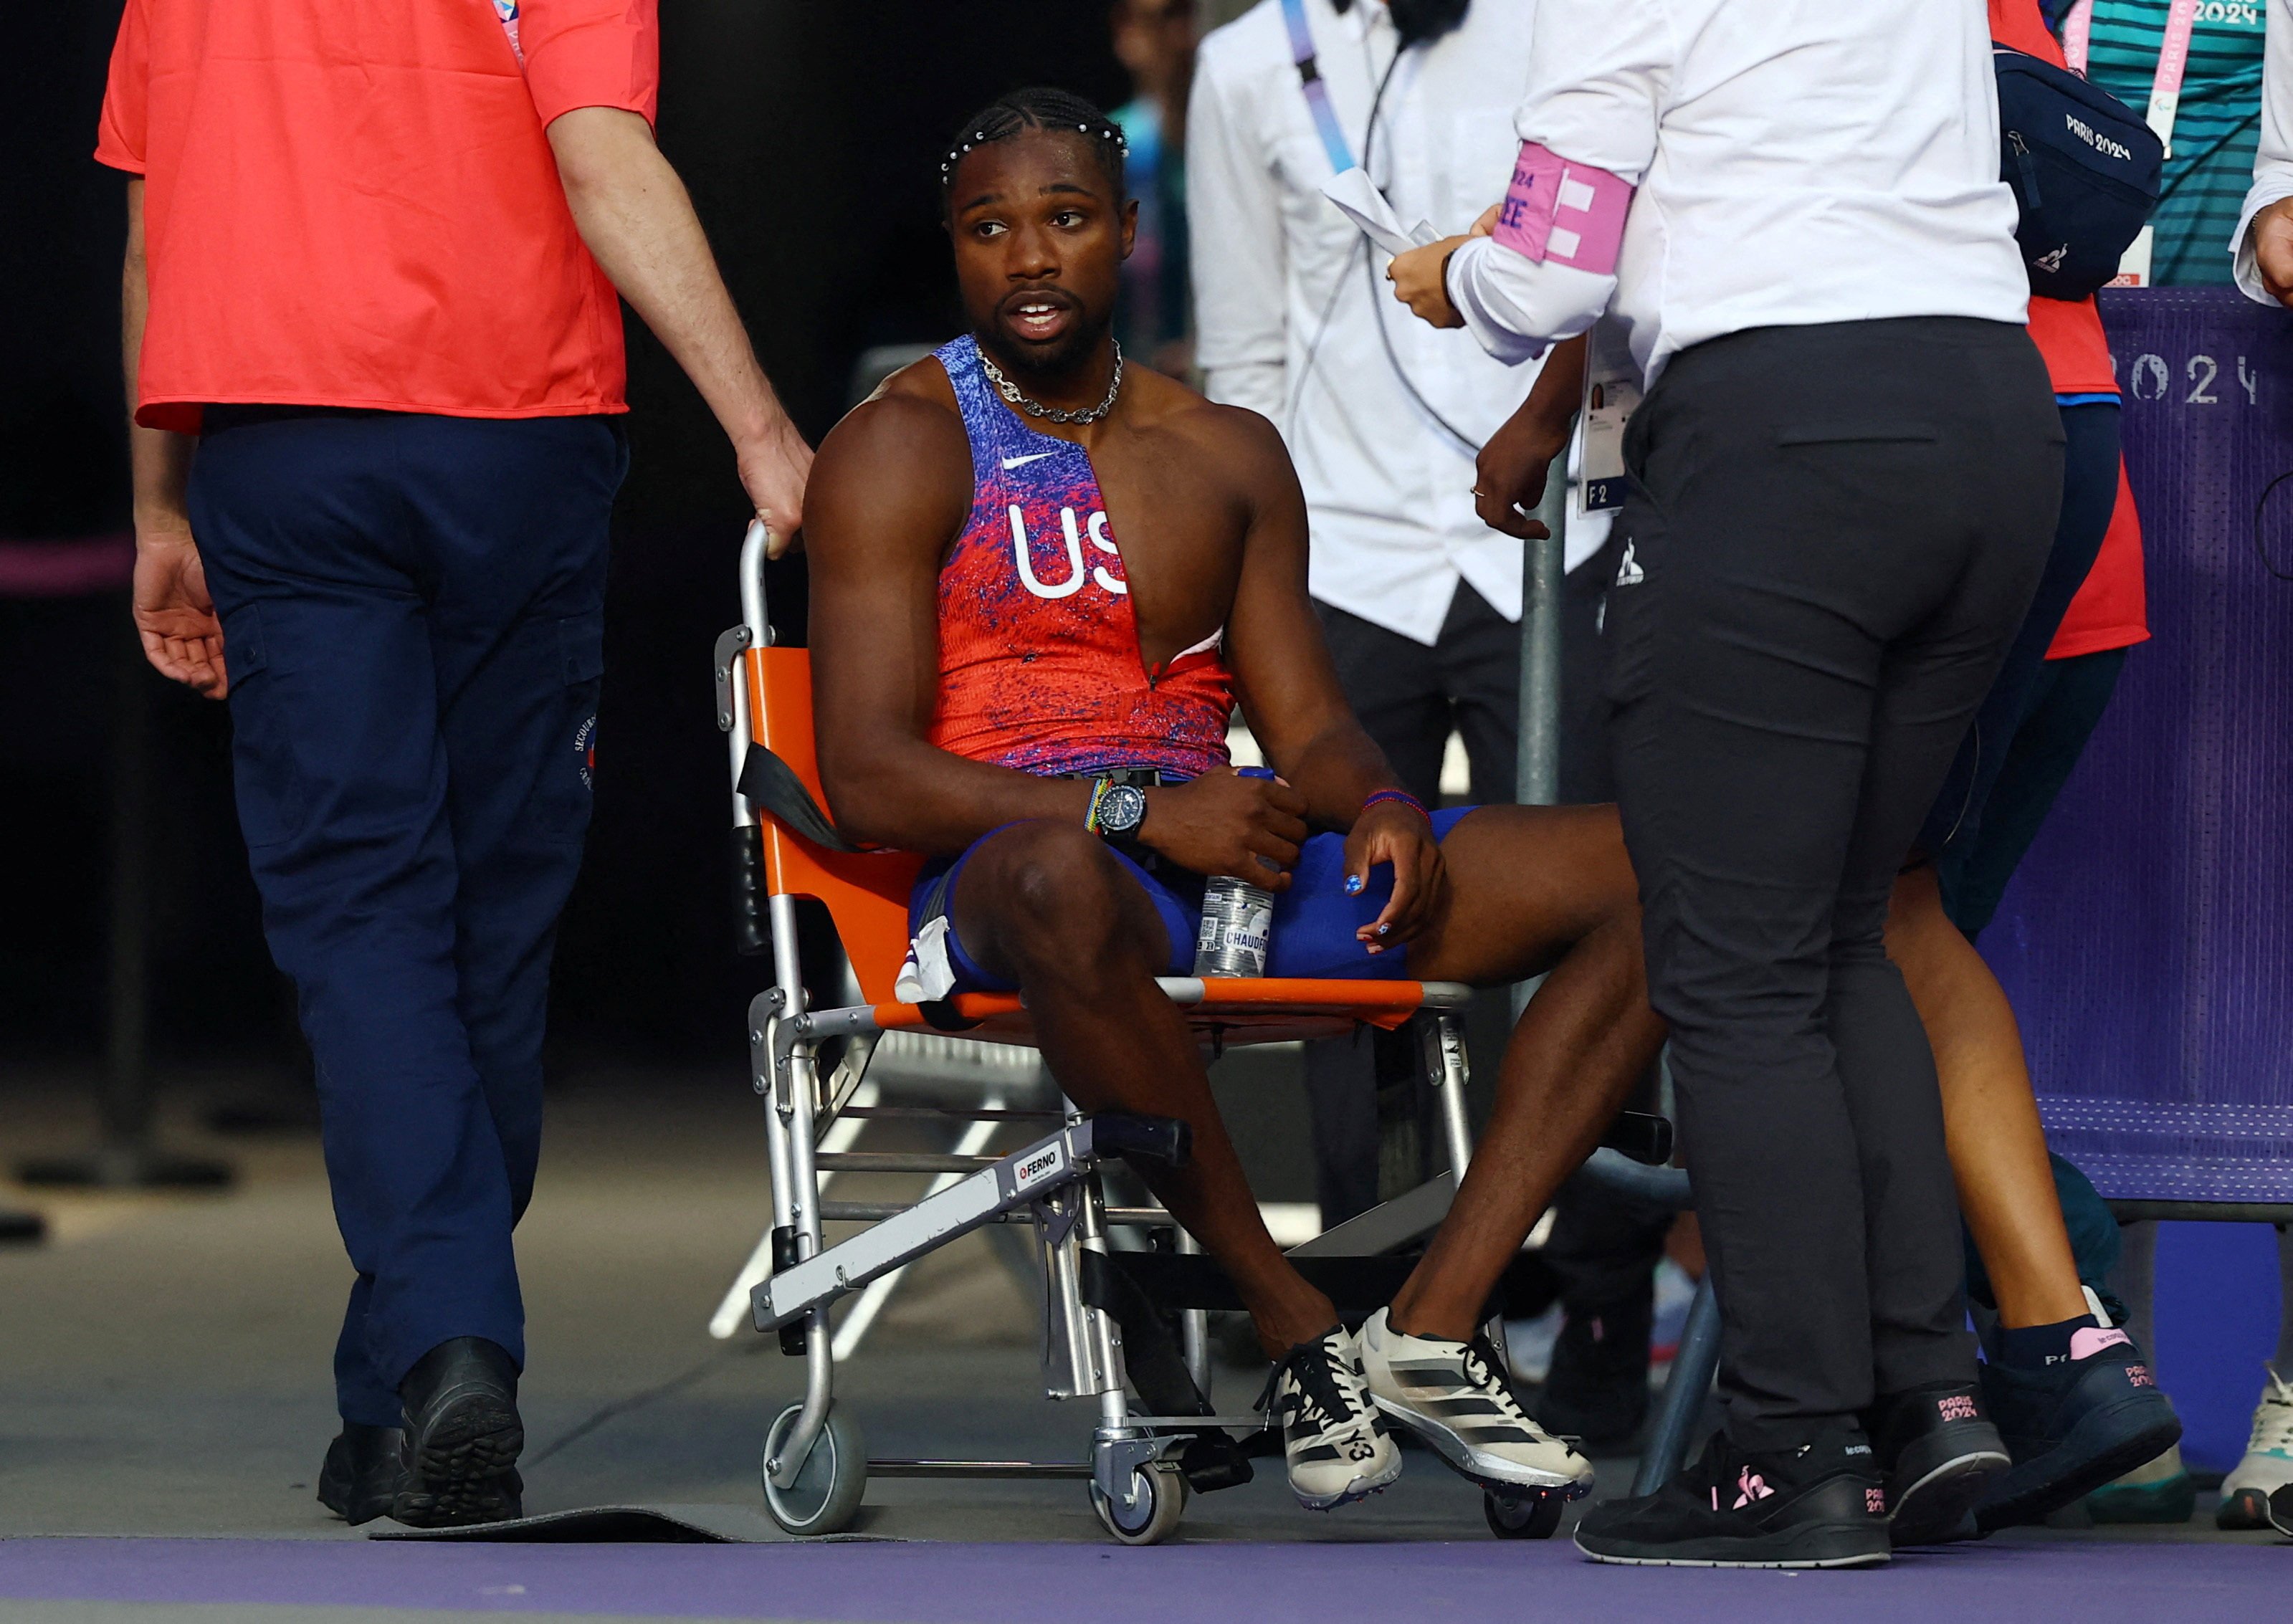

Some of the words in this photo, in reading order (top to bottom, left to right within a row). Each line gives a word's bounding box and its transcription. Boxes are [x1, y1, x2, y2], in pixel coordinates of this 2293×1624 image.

[2065, 113, 2094, 147] PARIS
[2095, 133, 2132, 161] 2024
[1027, 1151, 1056, 1177] FERNO
[1937, 1395, 1973, 1412] PARIS
[1941, 1405, 1978, 1423] 2024
